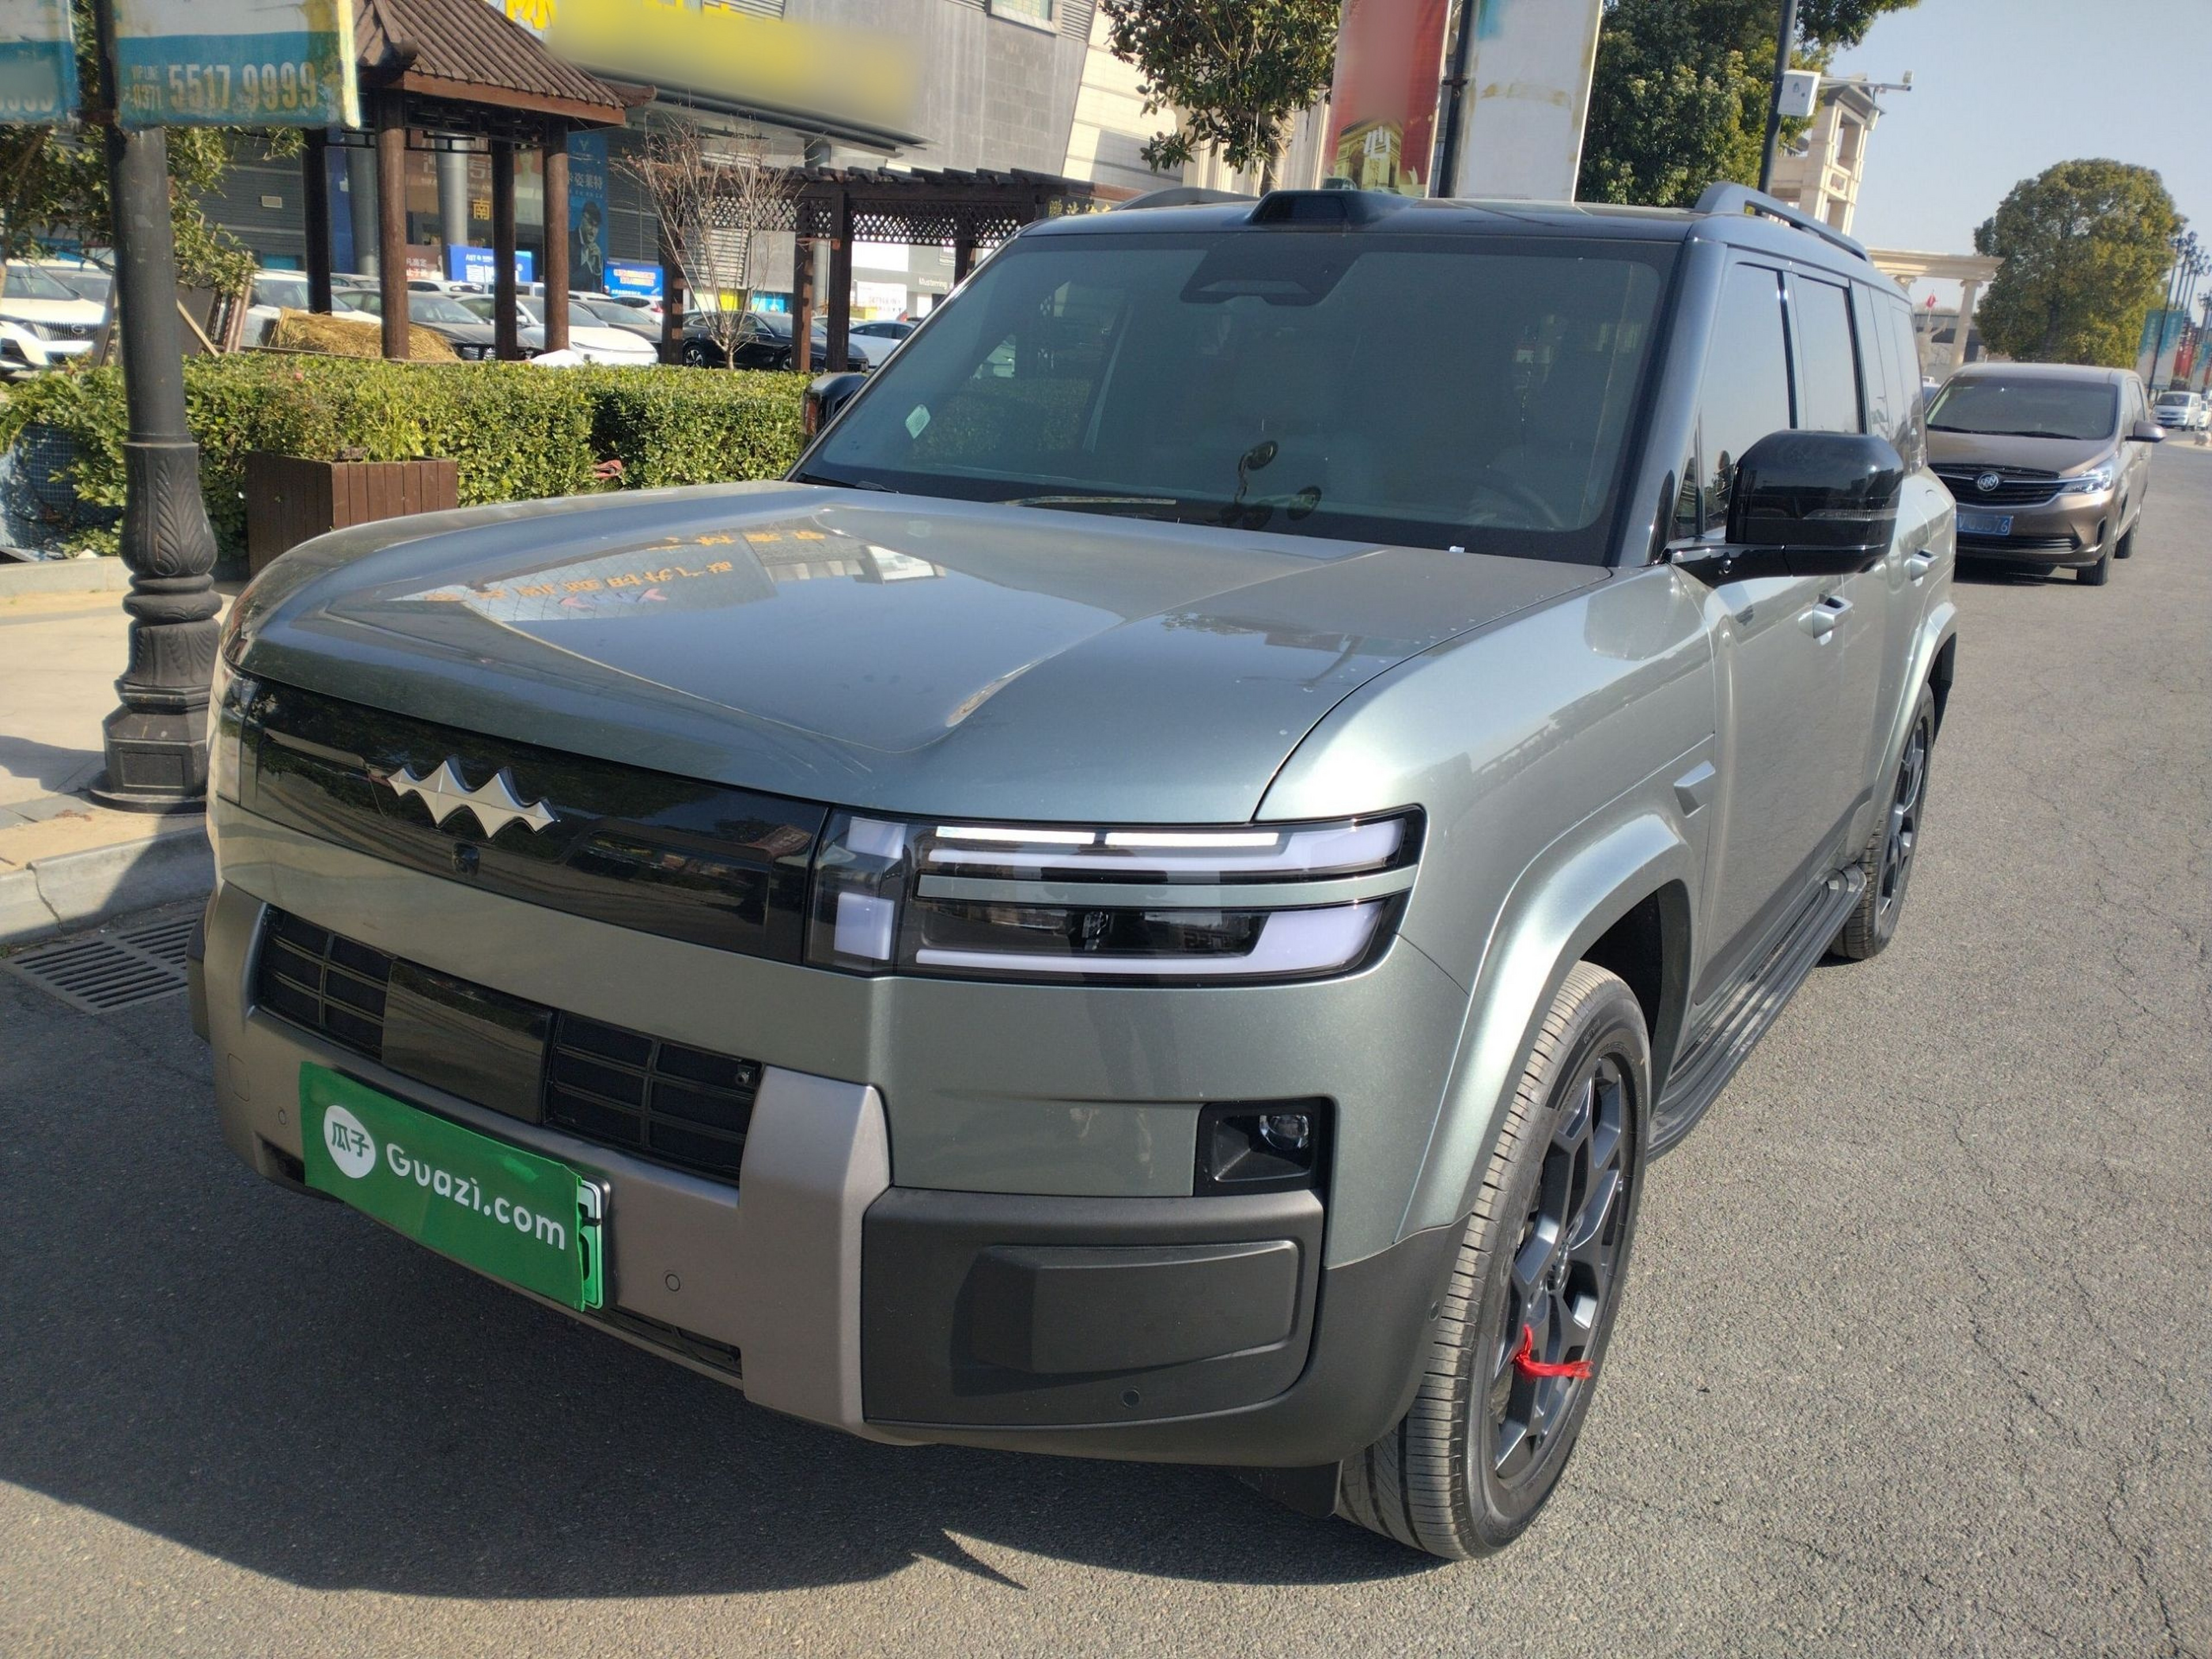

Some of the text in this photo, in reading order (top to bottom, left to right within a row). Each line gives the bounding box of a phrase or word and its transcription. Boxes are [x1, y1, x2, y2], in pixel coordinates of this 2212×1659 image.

[168, 63, 230, 111] 5517
[242, 62, 316, 112] 9999
[331, 1121, 370, 1158] 瓜子
[386, 1143, 565, 1251] Guazi.com
